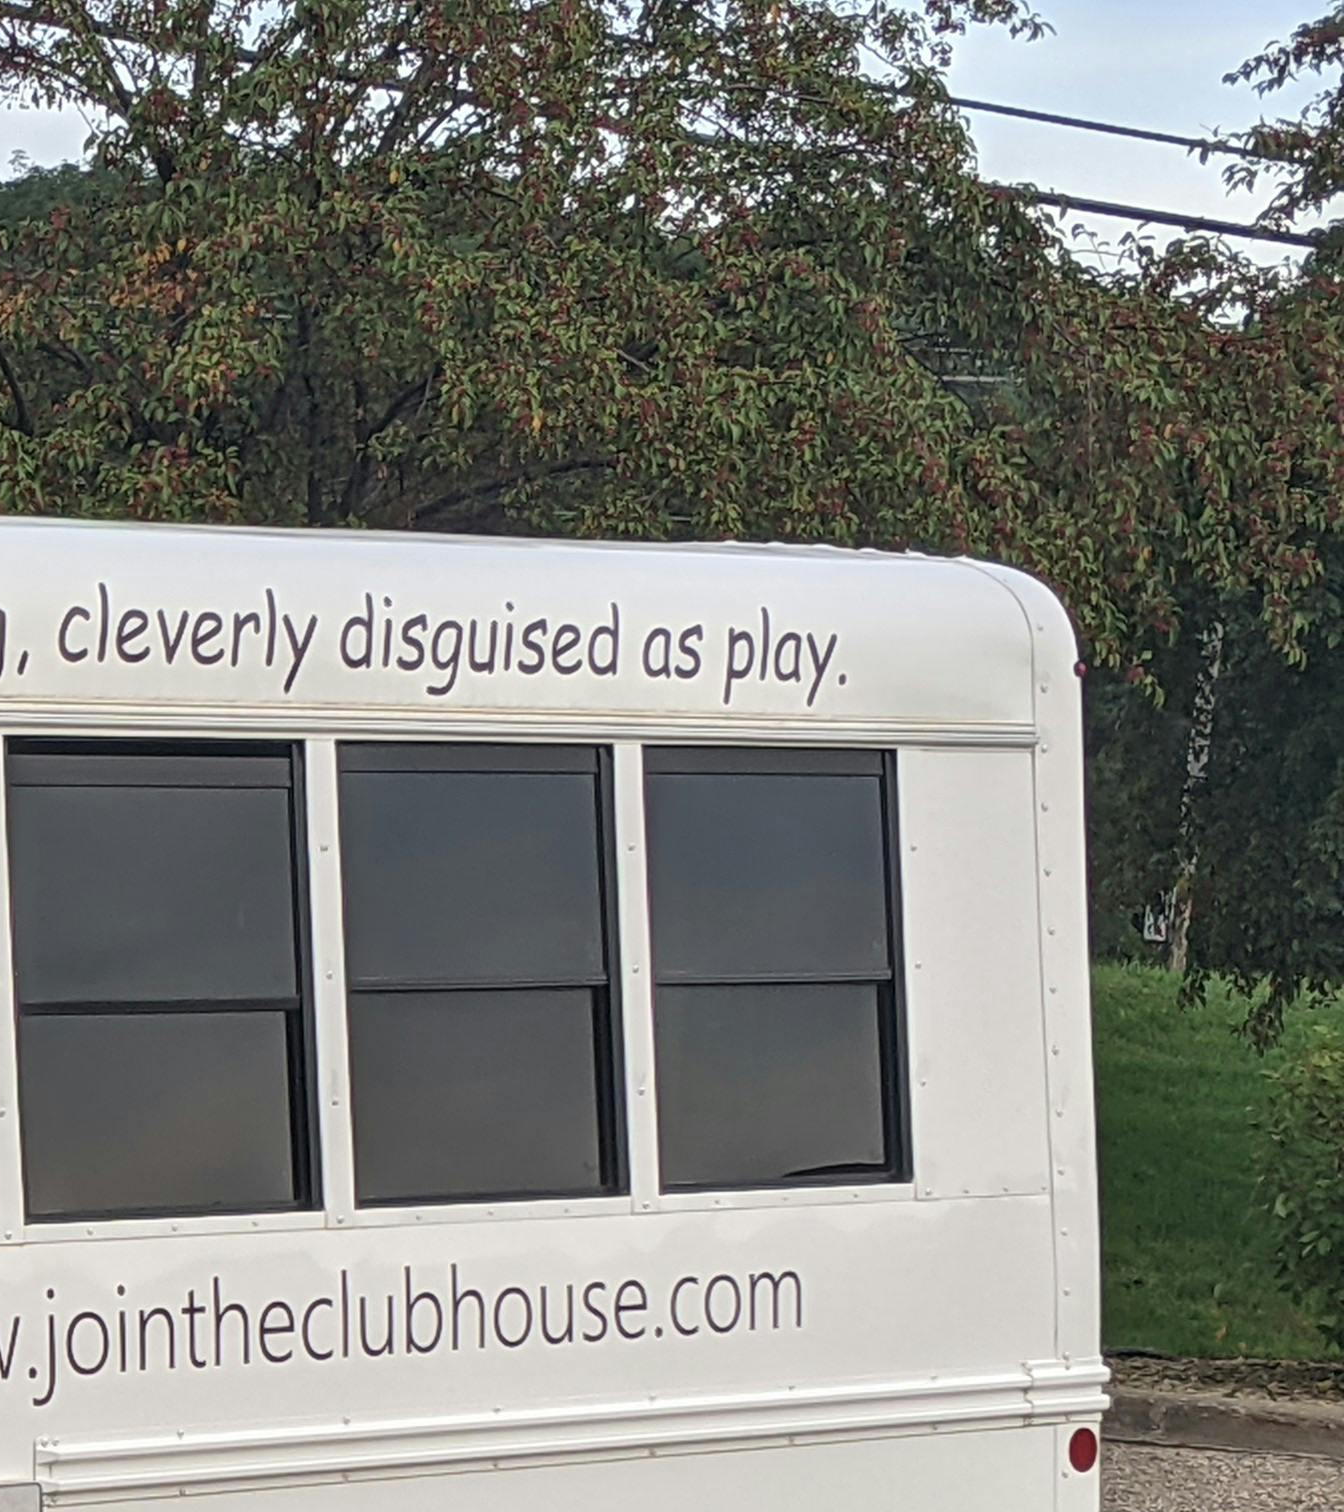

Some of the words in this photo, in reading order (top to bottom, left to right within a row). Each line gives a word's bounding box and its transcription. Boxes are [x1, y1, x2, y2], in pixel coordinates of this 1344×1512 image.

[58, 582, 319, 695] cleverly
[339, 592, 620, 696] disguised
[642, 623, 704, 680] as
[723, 606, 847, 708] play.
